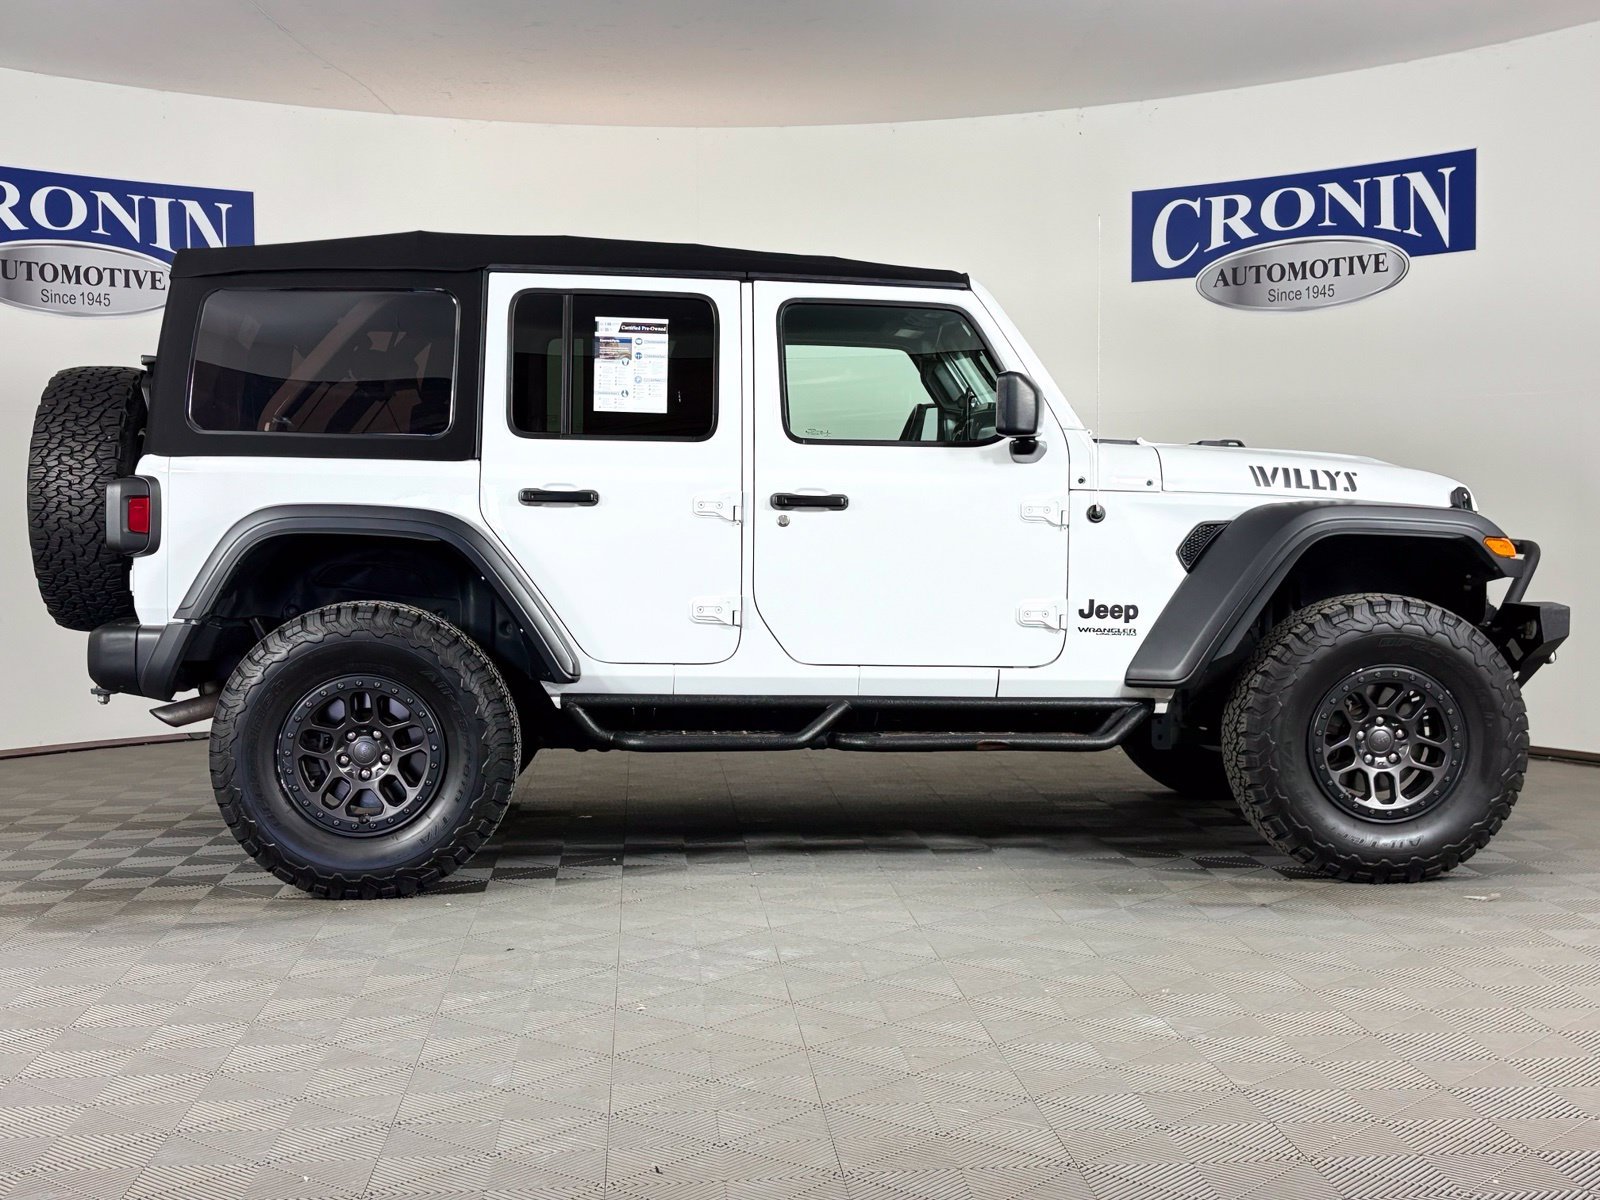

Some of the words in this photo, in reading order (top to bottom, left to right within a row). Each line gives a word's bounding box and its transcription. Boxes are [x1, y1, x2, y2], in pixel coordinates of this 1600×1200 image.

[0, 180, 233, 253] RONIN
[1152, 166, 1457, 269] CRONIN
[0, 258, 166, 291] UTOMOTIVE
[1213, 252, 1390, 288] AUTOMOTIVE
[40, 288, 77, 305] Since
[79, 291, 111, 307] 1945
[1267, 287, 1302, 303] Since
[1305, 283, 1336, 300] 1945
[1248, 465, 1358, 492] WILLYS
[1078, 598, 1139, 623] Jeep
[1077, 626, 1137, 635] WRANGLER
